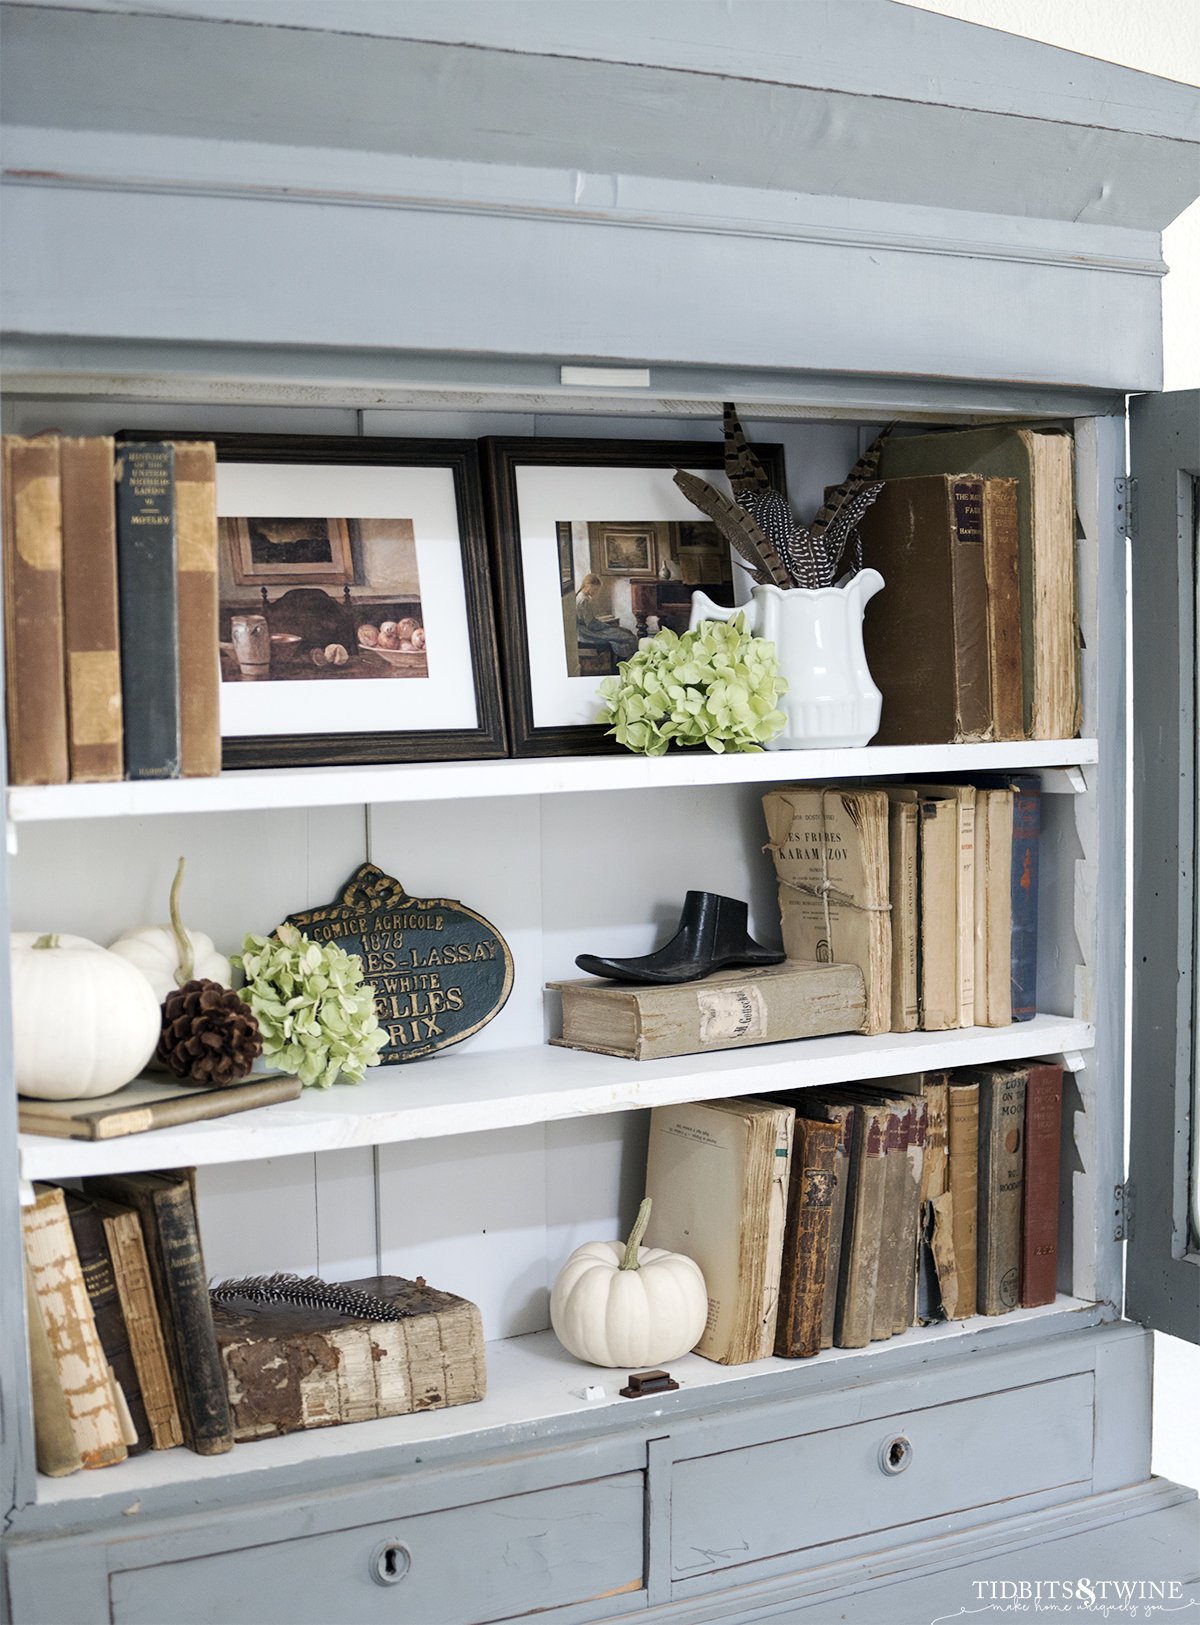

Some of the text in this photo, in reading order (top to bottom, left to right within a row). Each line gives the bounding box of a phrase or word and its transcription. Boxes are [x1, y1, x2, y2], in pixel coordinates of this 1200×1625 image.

[131, 469, 168, 478] UNITED
[955, 493, 969, 501] THE
[130, 516, 170, 525] MOTLEY
[786, 832, 801, 842] ES
[779, 847, 848, 861] KARAMZOV
[313, 914, 444, 942] COMICE AGRICOLE
[361, 931, 404, 952] 1878
[374, 987, 465, 1020] ELLES
[387, 1014, 444, 1047] RIX
[1002, 1092, 1013, 1102] ON
